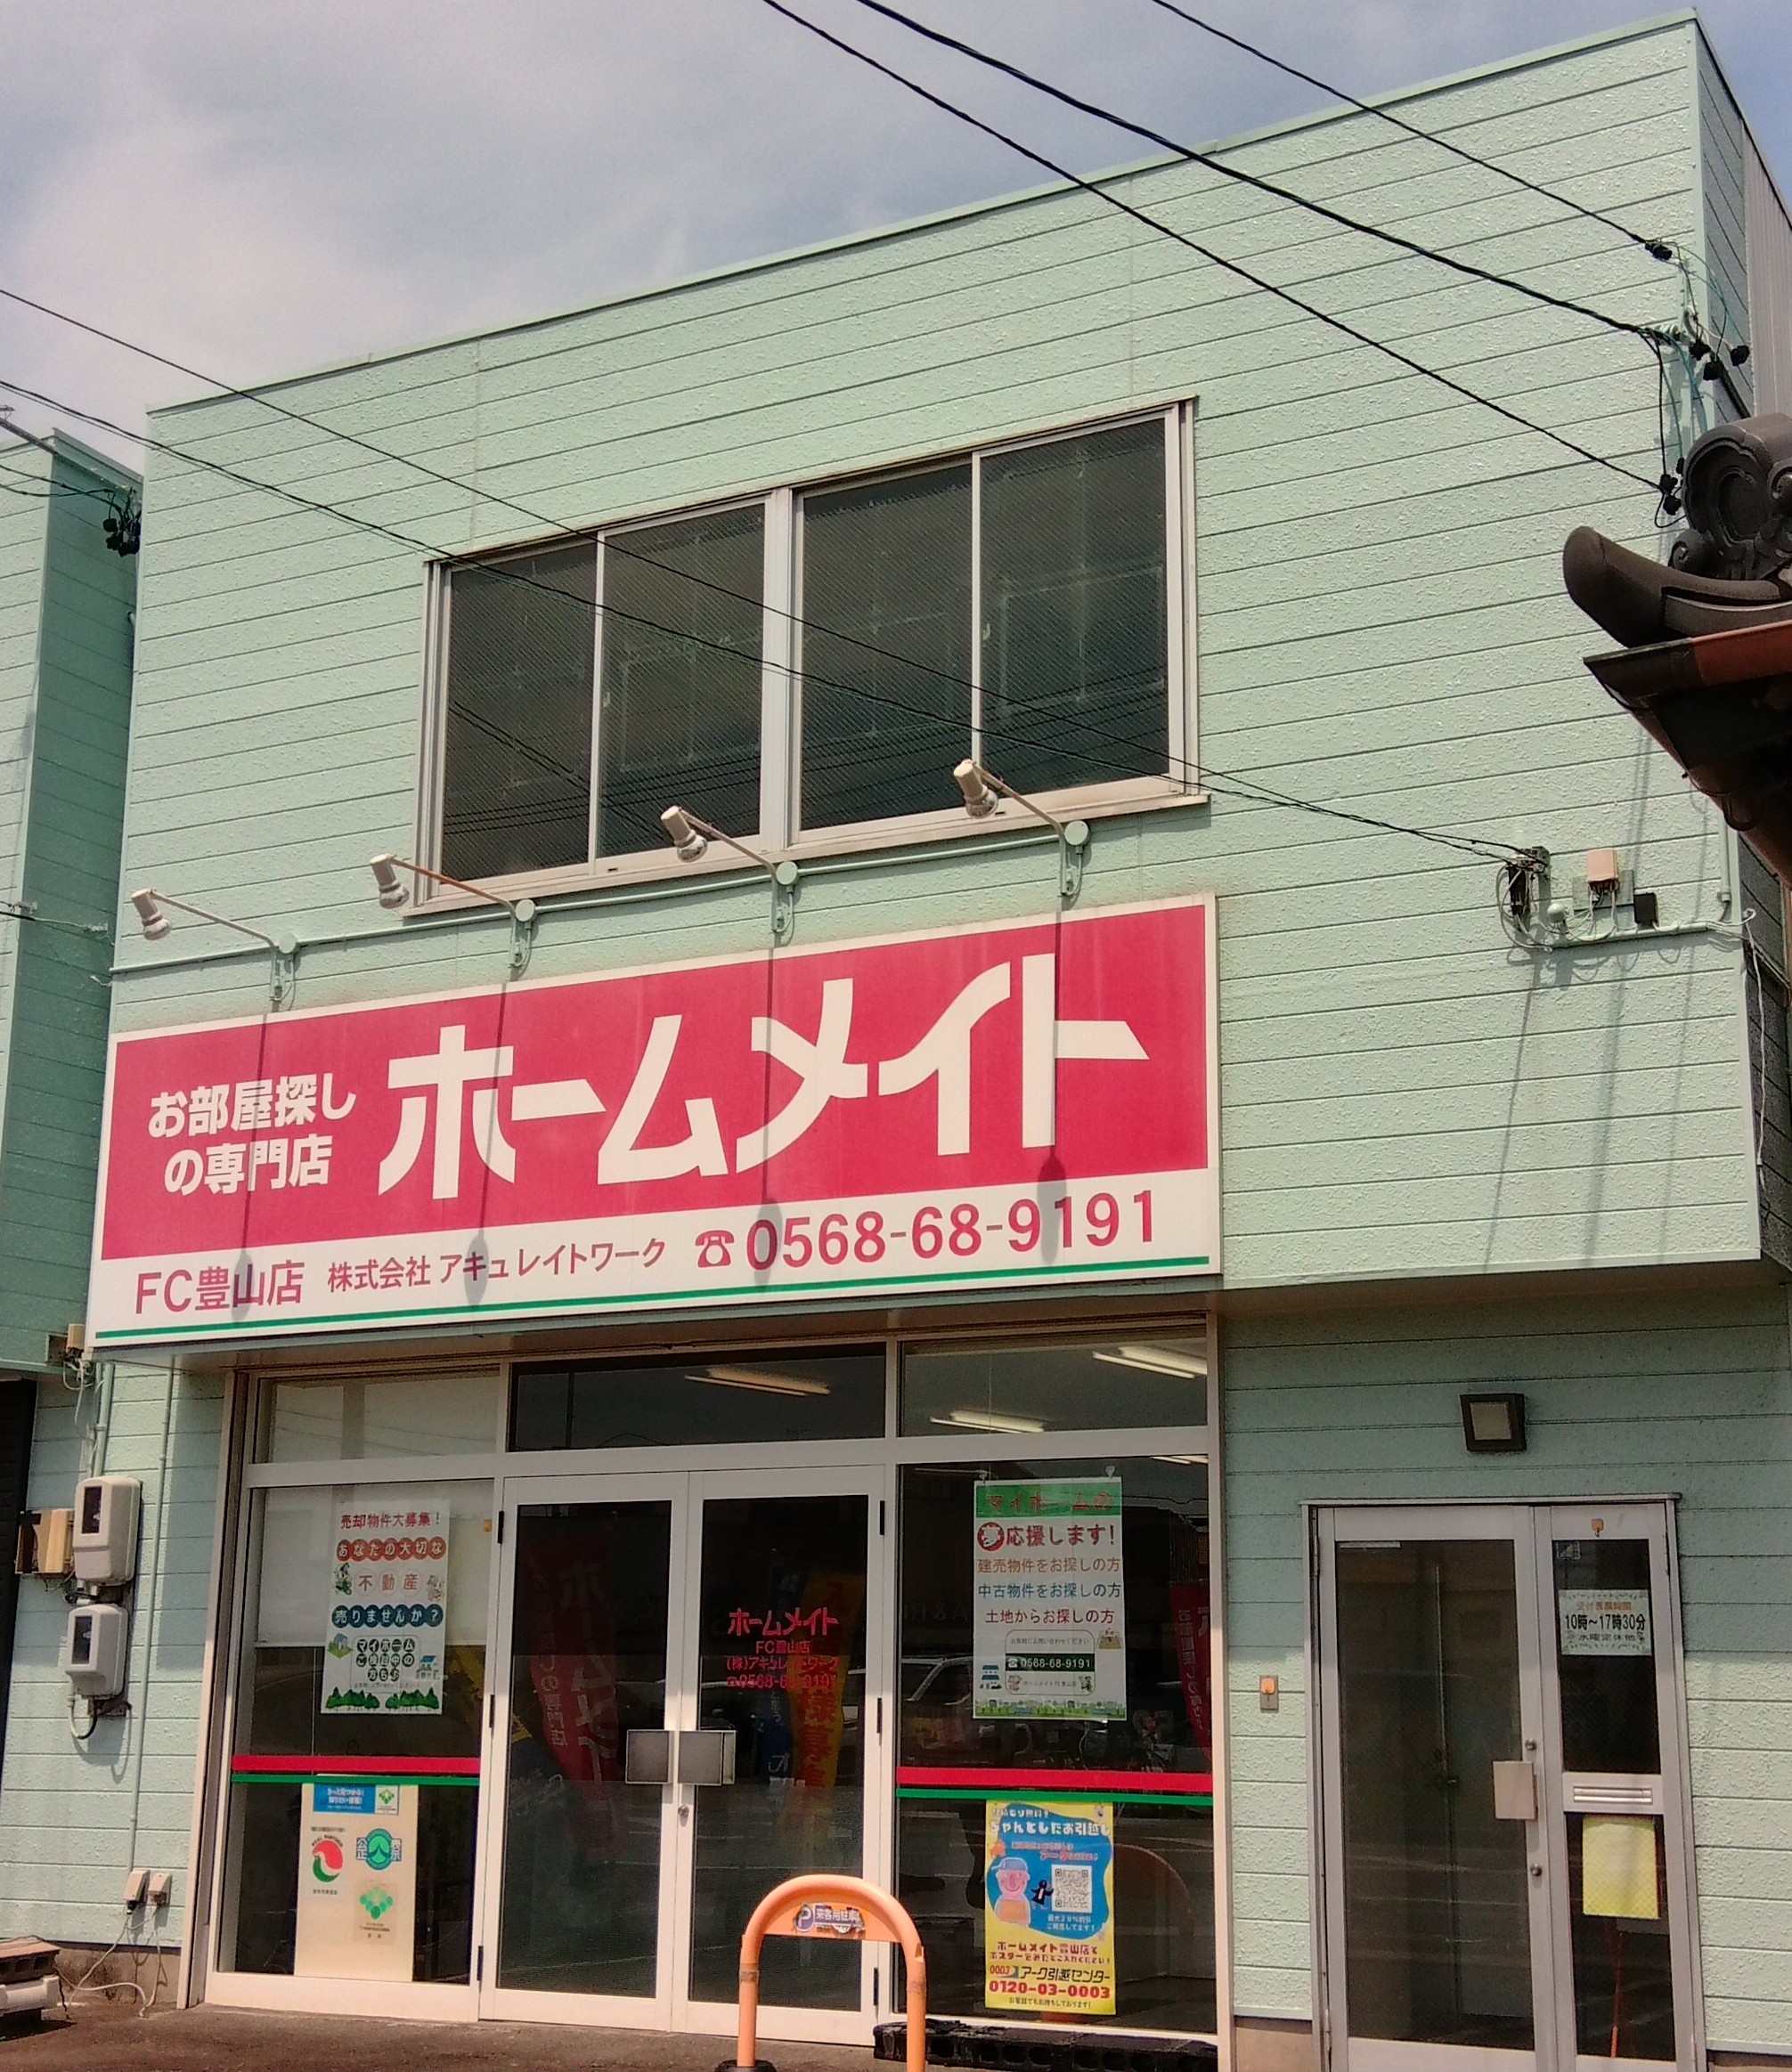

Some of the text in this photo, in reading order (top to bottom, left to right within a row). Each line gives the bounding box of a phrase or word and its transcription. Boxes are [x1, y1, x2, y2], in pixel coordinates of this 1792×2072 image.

[378, 954, 1150, 1199] ホームメイト
[147, 1073, 356, 1139] お部屋探し
[164, 1134, 334, 1196] の専門店
[746, 1190, 1153, 1271] 0568-68-9191
[135, 1259, 305, 1315] FC豊山店
[986, 1491, 1113, 1514] マイホムの
[338, 1540, 444, 1559] あなたの大切な
[978, 1556, 1120, 1574] 建売物件をお探しの方
[358, 1572, 419, 1592] 不動産
[978, 1582, 1121, 1599] 中古物件をお探しの方
[728, 1607, 839, 1636] ホームメイト
[985, 1608, 1114, 1624] 土地からお探しの方
[357, 1638, 415, 1653] マイホーム
[726, 1655, 839, 1672] (株)アキュレトワーク
[738, 1674, 837, 1689] 0568-6-9191
[989, 1980, 1111, 1999] 0120-03-0003
